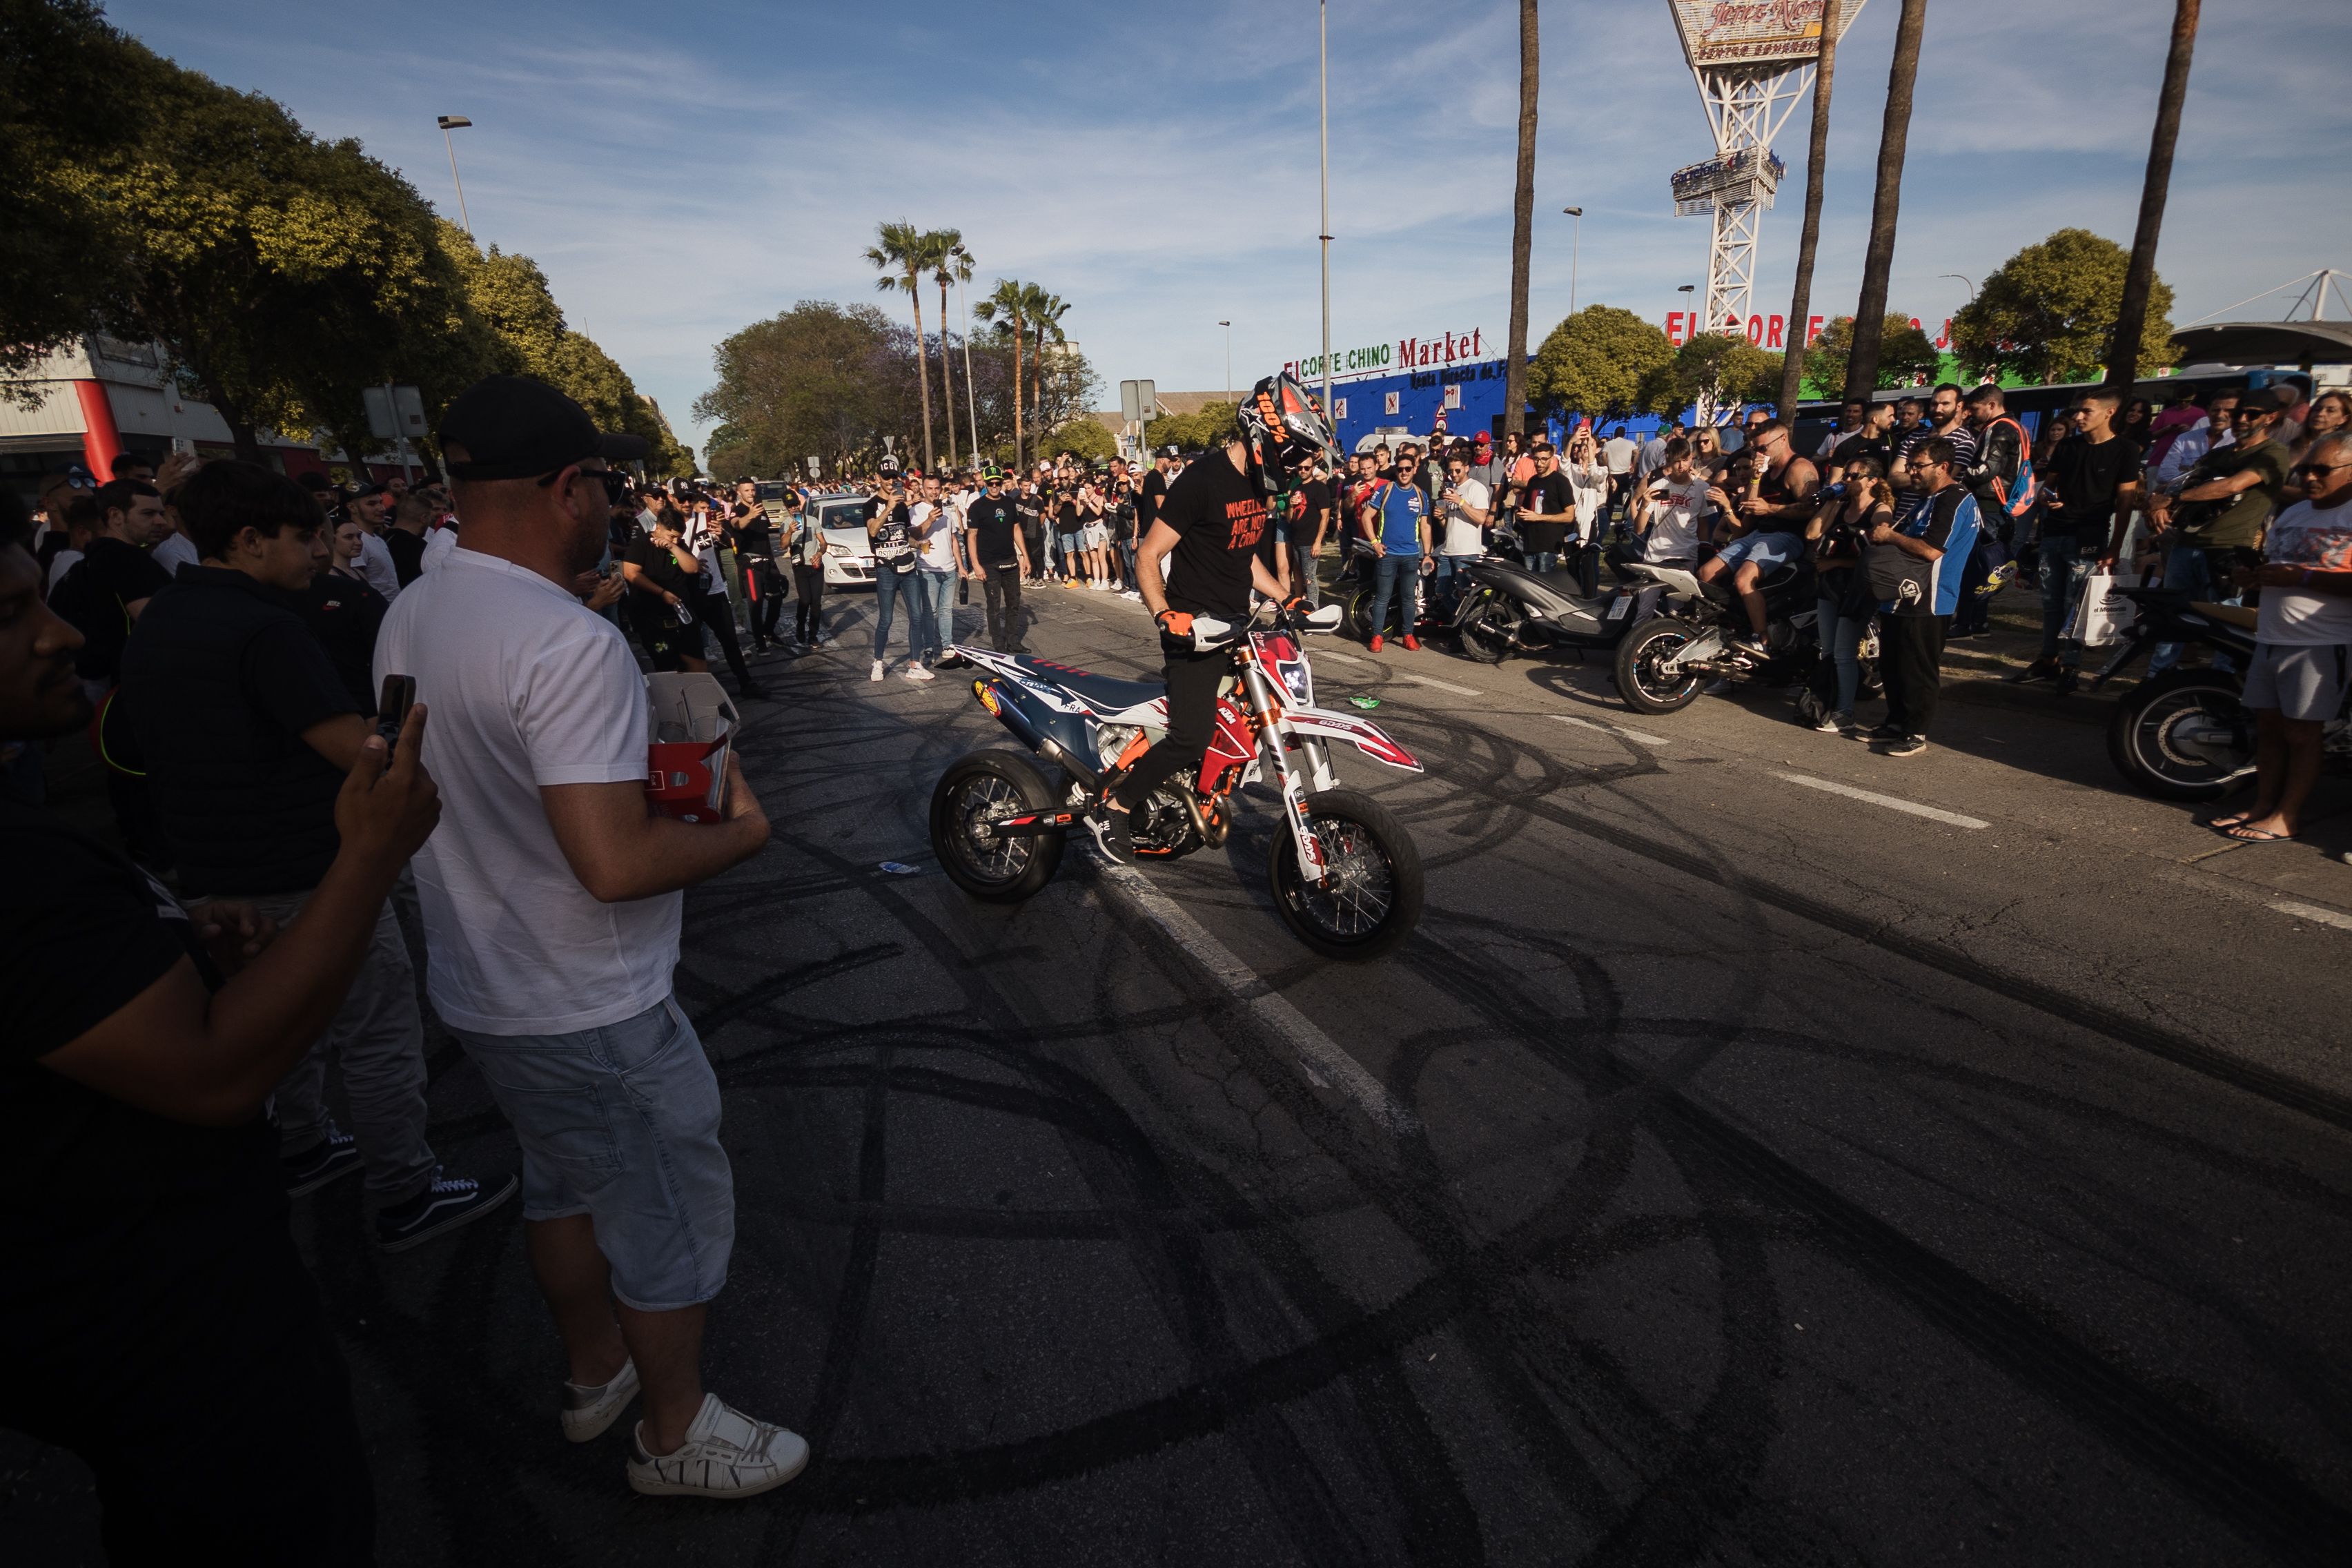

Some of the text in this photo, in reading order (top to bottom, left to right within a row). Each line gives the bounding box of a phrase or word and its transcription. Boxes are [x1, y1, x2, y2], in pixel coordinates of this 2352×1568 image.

[1349, 344, 1390, 369] CHINO
[1400, 326, 1480, 369] Market
[1410, 371, 1436, 389] Venta
[1440, 364, 1476, 386] Directa
[1257, 391, 1290, 444] 100%
[1231, 514, 1266, 536] ARE NOT
[1228, 535, 1237, 550] A
[1064, 703, 1081, 714] FRA
[1218, 707, 1236, 725] KTM
[1318, 720, 1353, 730] 6DAYS
[1300, 825, 1317, 861] 6DAYS
